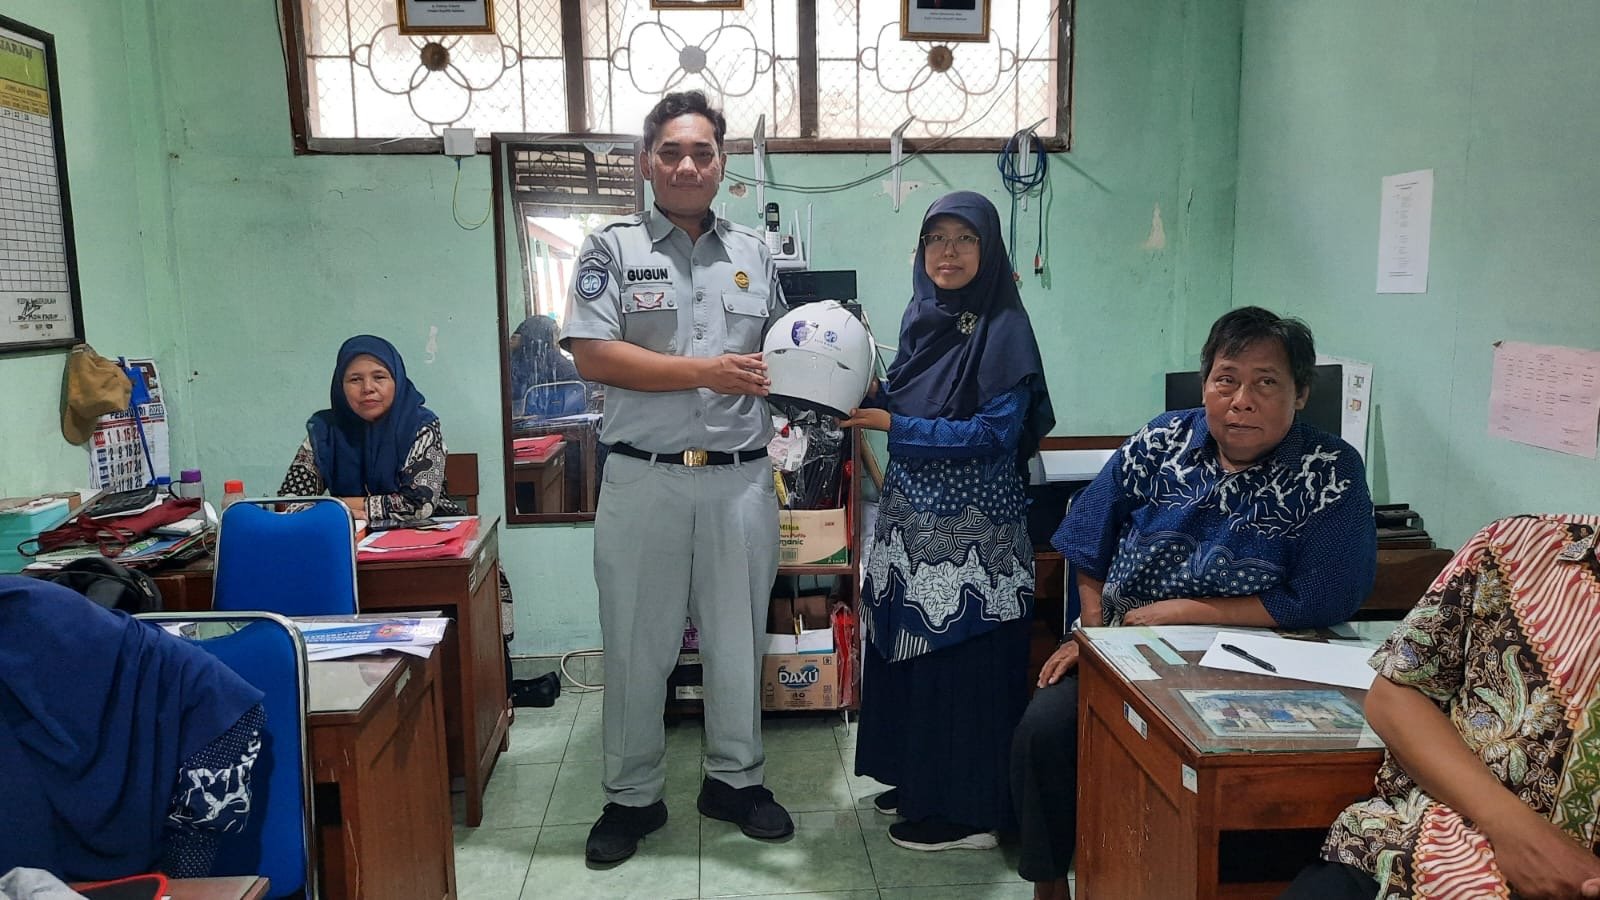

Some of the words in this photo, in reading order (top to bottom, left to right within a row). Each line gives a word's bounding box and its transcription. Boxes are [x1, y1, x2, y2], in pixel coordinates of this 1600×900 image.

[627, 268, 668, 282] GUGUN
[110, 405, 146, 419] FEBRURI
[110, 447, 114, 460] 2
[118, 446, 122, 459] 9
[125, 444, 132, 457] 16
[133, 442, 141, 456] 23
[125, 461, 132, 473] 17
[134, 459, 142, 472] 24
[779, 538, 804, 546] rganic
